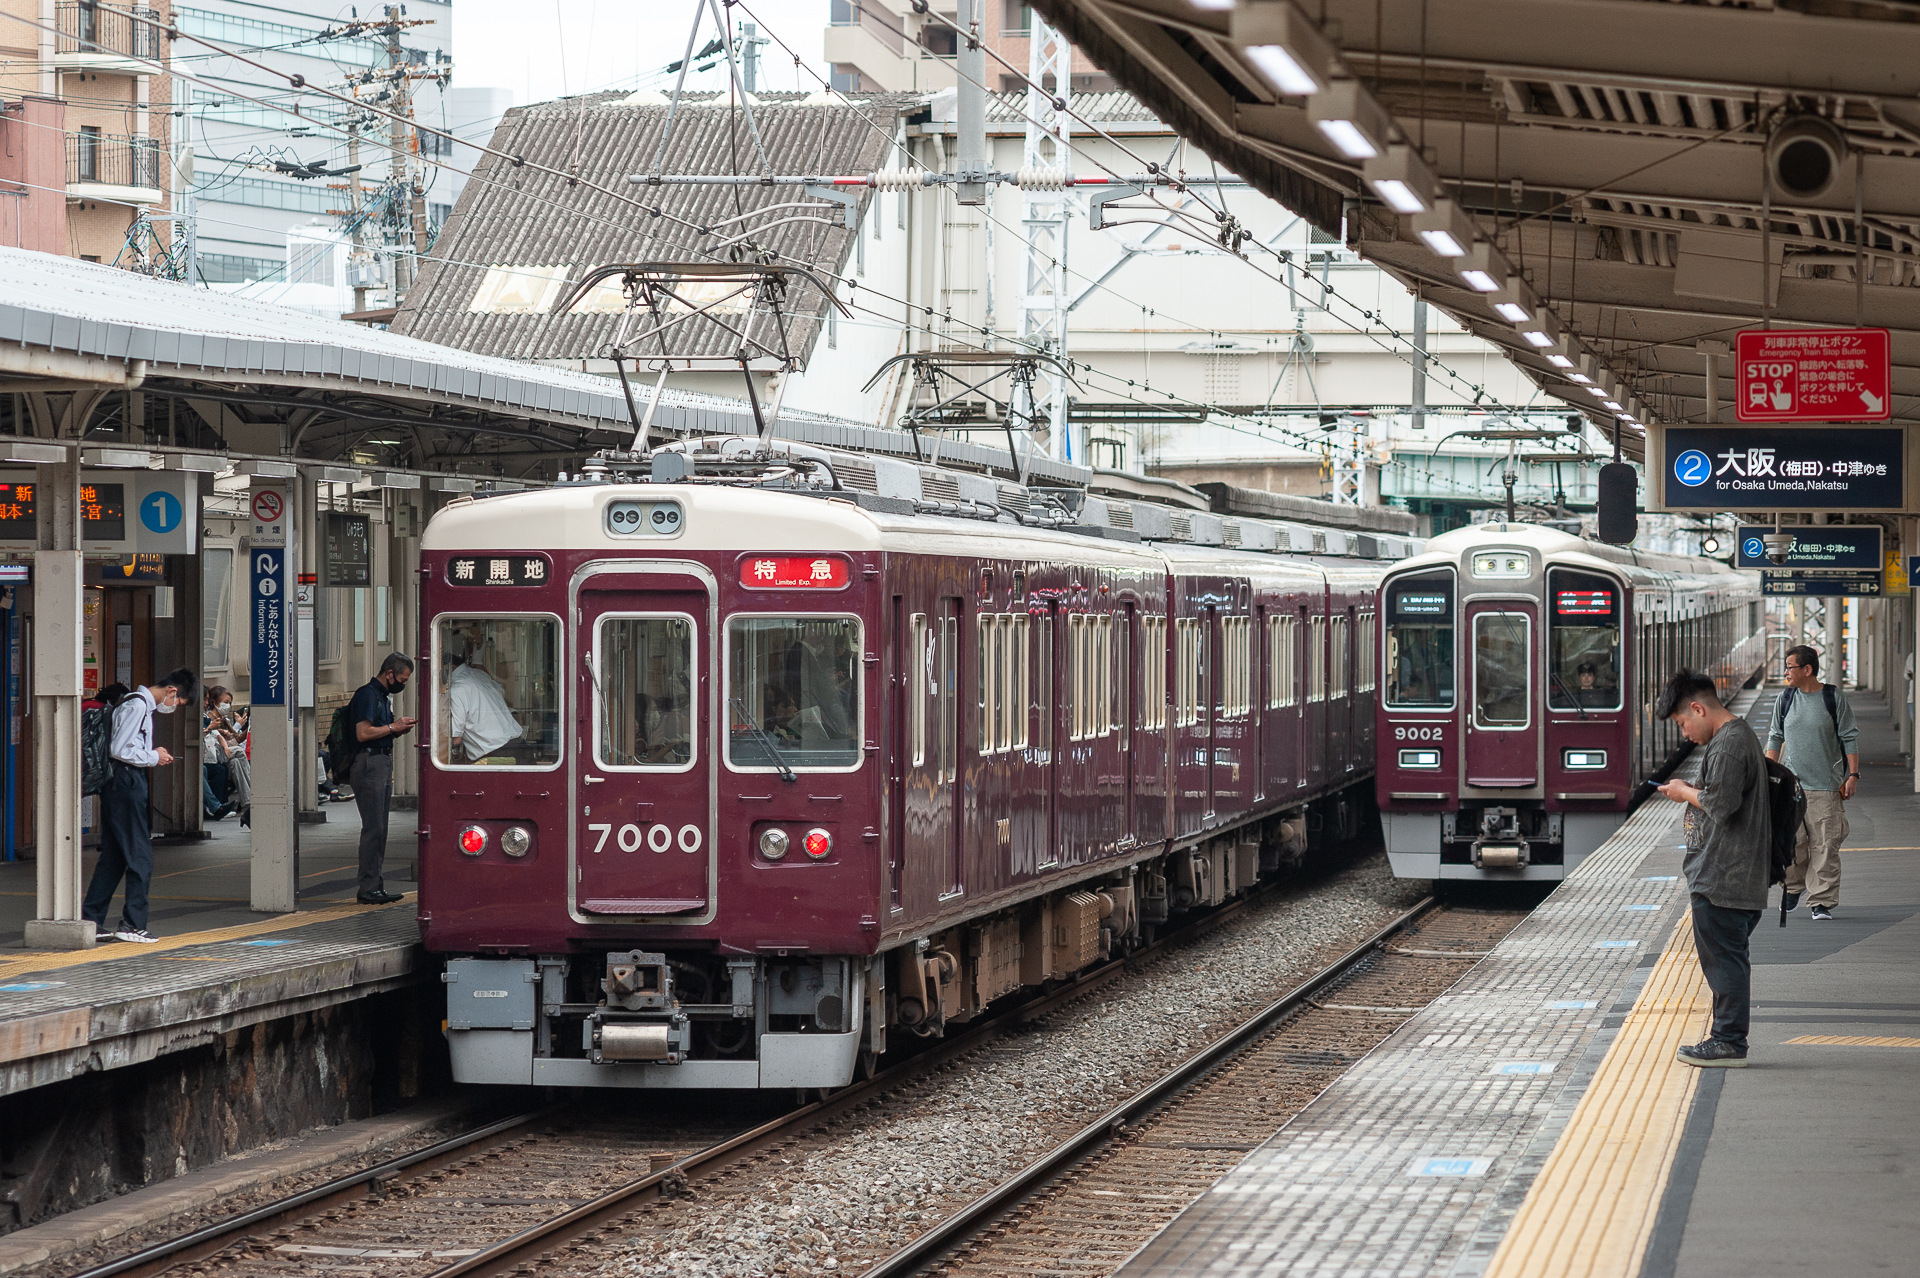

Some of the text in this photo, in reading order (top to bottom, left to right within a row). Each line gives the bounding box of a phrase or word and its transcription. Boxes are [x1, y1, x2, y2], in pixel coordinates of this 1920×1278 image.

[1764, 336, 1862, 349] 列車非常停止ボタン
[1759, 347, 1867, 358] Emergency Train Stop Button
[1747, 364, 1793, 378] STOP
[1799, 371, 1855, 381] 緊急の場合に
[1799, 382, 1865, 393] ボタンを押して
[1800, 394, 1838, 404] ください
[1683, 455, 1702, 480] 2
[1716, 480, 1730, 490] for
[1732, 480, 1765, 490] Osaka
[152, 497, 167, 527] 1
[255, 525, 280, 535] 禁煙
[1748, 540, 1759, 555] 2
[455, 559, 544, 580] 新開地
[753, 559, 833, 580] 特急
[258, 599, 266, 644] Information
[268, 599, 279, 698] ごあんないカウンター
[1394, 727, 1444, 741] 9002
[588, 823, 702, 853] 7000
